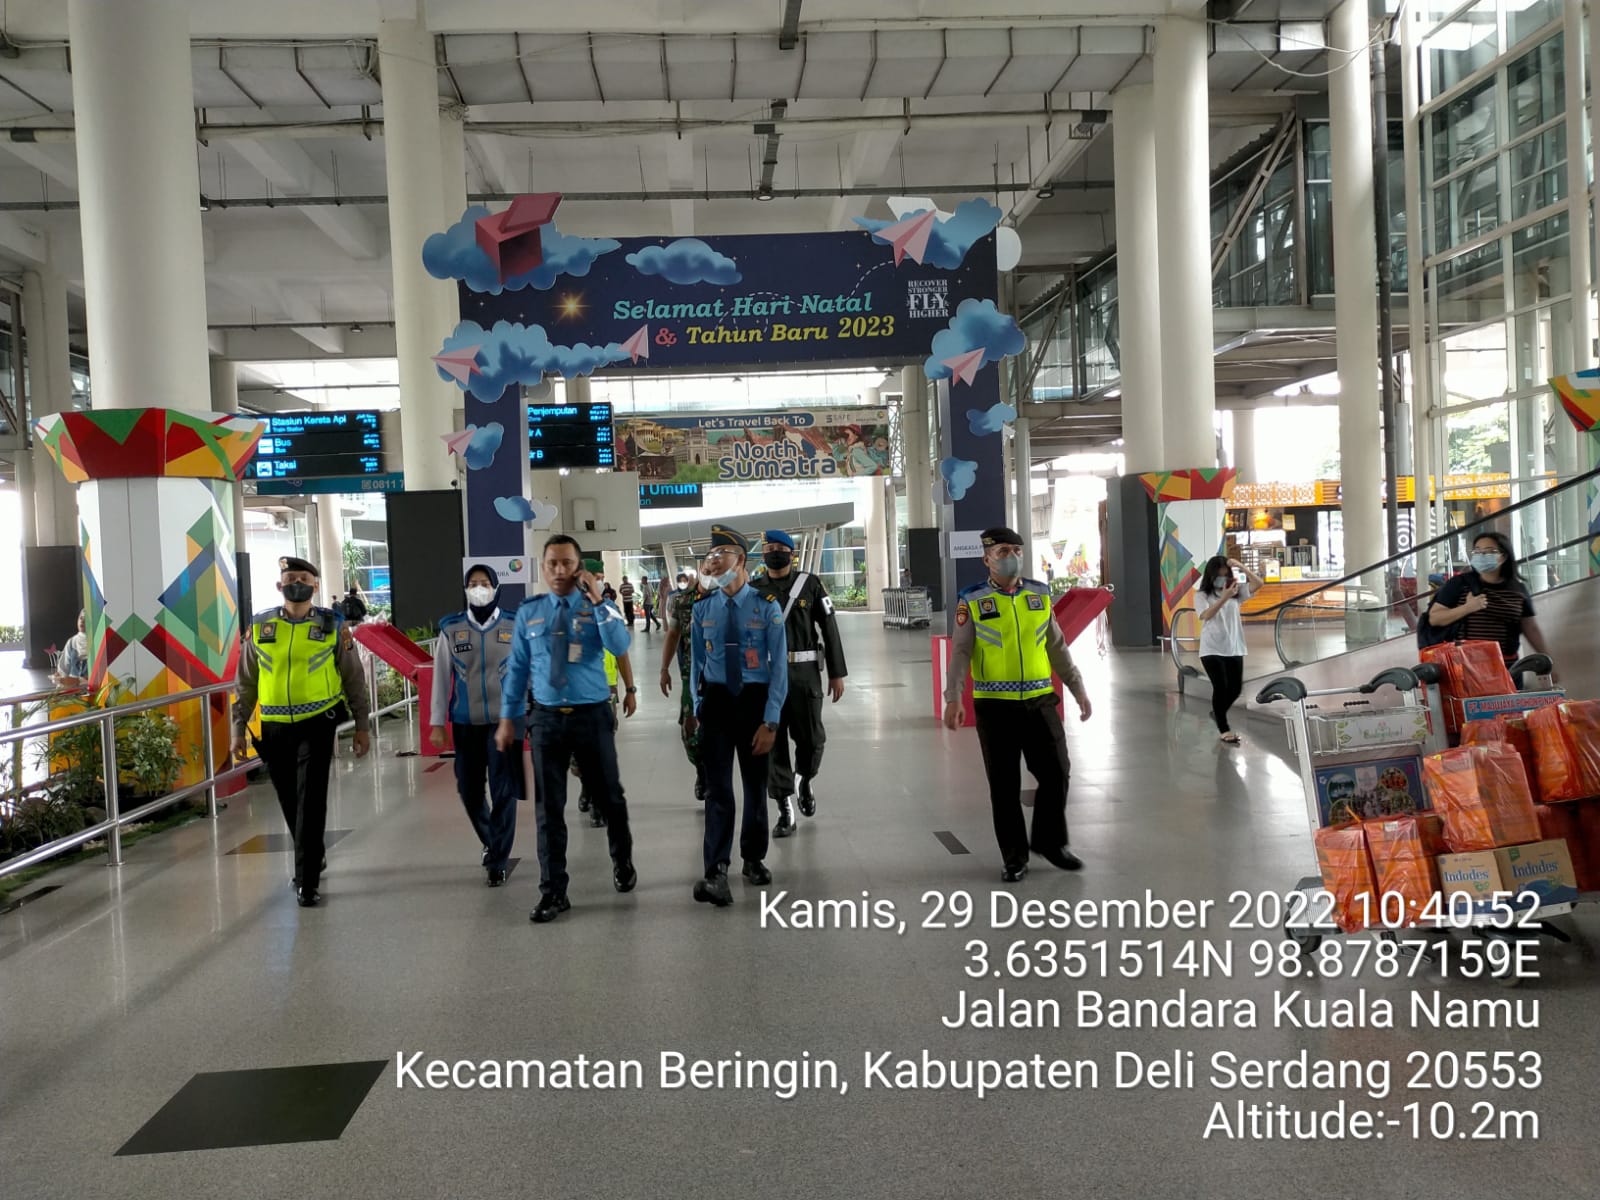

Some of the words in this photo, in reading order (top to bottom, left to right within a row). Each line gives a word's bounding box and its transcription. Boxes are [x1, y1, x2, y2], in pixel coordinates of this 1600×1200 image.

[908, 279, 948, 288] RECOVER
[908, 286, 948, 294] STRONGER
[613, 299, 726, 320] Selamat
[732, 295, 793, 318] Hari
[800, 292, 873, 315] Natal
[909, 292, 949, 310] FLY
[909, 309, 949, 319] HIGHER
[655, 327, 678, 346] &
[685, 324, 764, 345] Tahun
[770, 323, 830, 342] Baru
[838, 315, 896, 339] 2023
[527, 406, 578, 416] Penjemputan
[271, 417, 303, 427] Stasiun
[303, 416, 331, 425] Kereta
[333, 415, 347, 425] Api
[698, 417, 721, 429] Let's
[721, 416, 761, 428] Travel
[763, 416, 790, 427] Back
[791, 415, 806, 426] To
[274, 438, 292, 447] Bus
[733, 439, 798, 461] North
[273, 460, 297, 470] Taksi
[718, 456, 837, 480] Sumatra
[372, 480, 397, 489] 0811
[650, 483, 698, 496] Umum
[1444, 869, 1489, 883] Indodes
[1511, 860, 1559, 879] Indodes
